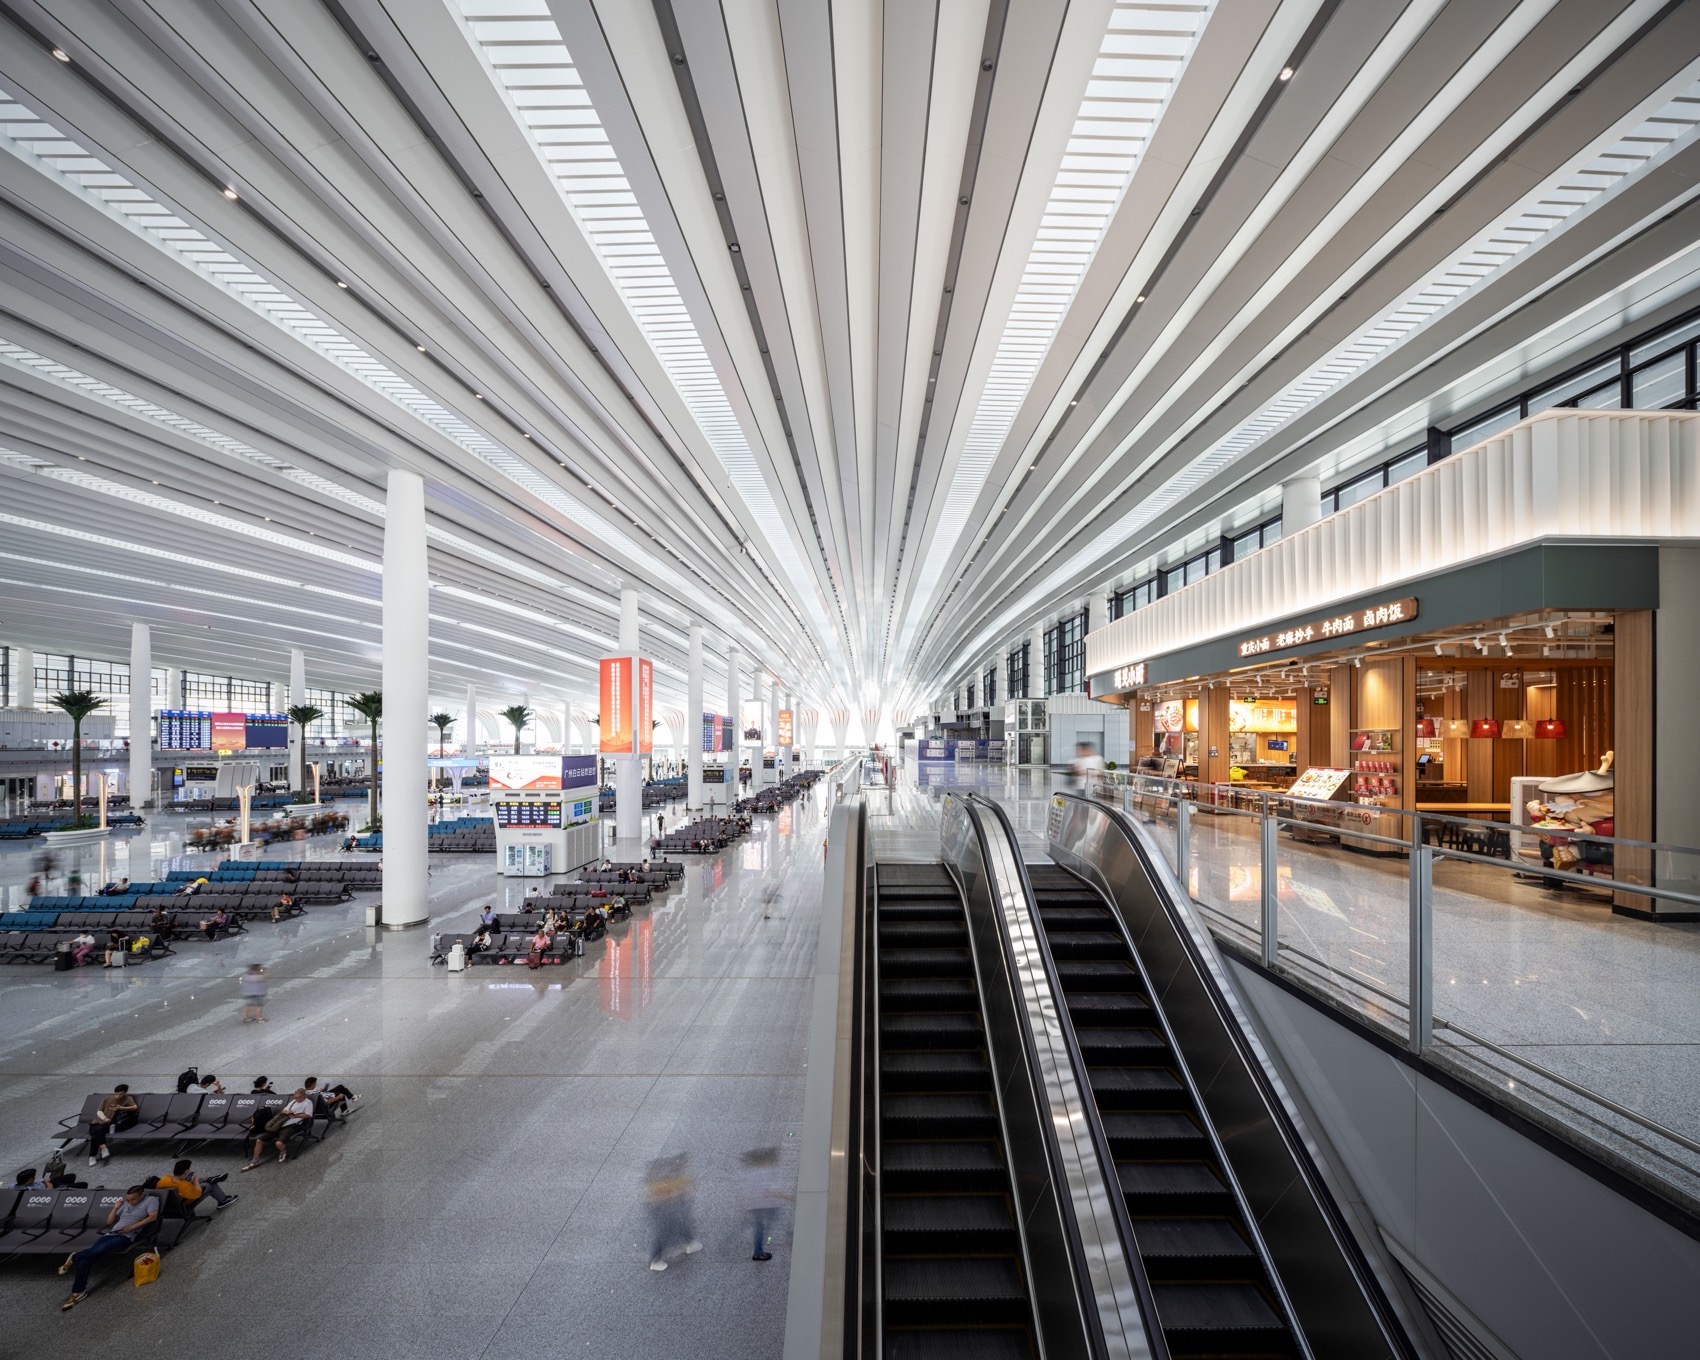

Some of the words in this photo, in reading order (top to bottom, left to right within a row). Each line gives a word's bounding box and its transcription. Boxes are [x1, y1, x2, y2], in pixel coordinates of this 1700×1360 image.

[1240, 637, 1270, 656] 重庆小面
[1276, 625, 1314, 647] 老麻抄手
[1321, 615, 1354, 636] 牛肉面
[1363, 603, 1404, 627] 卤肉饭
